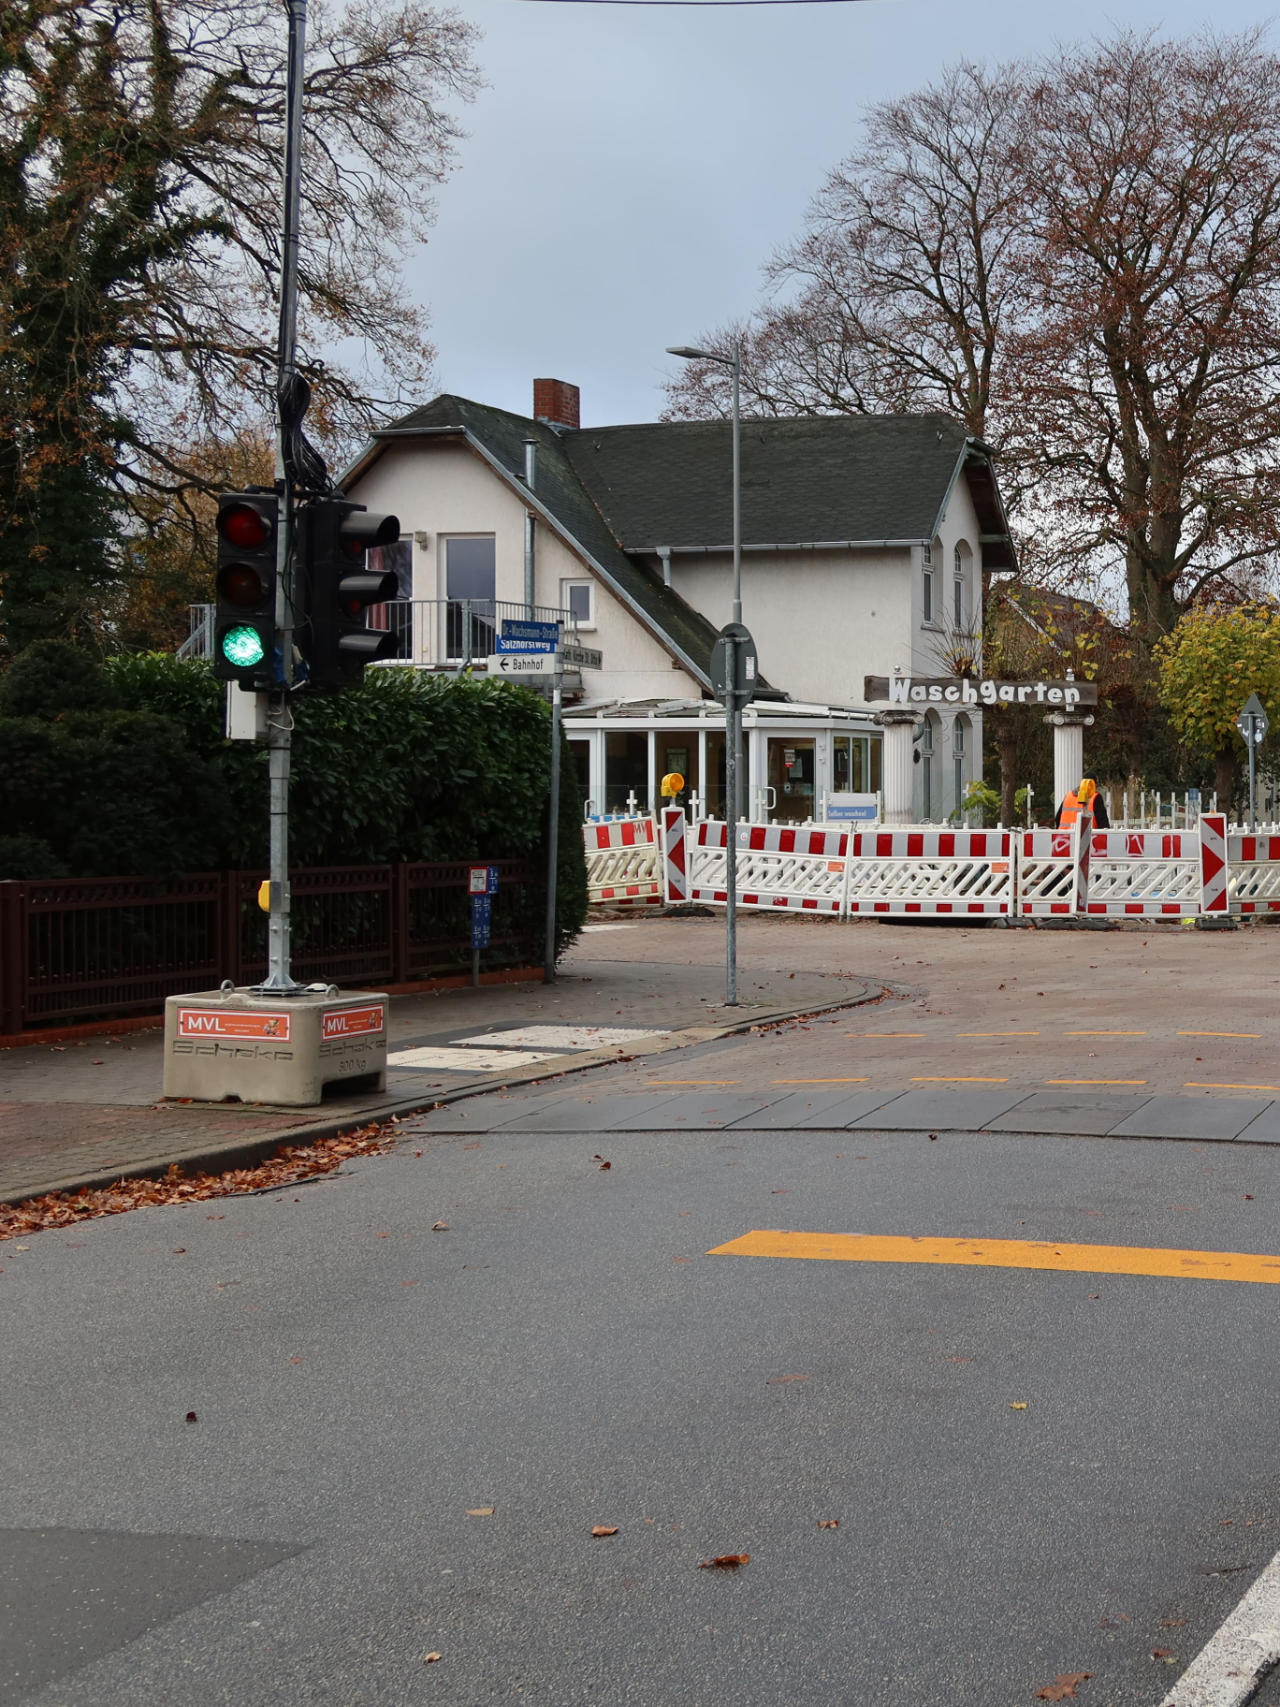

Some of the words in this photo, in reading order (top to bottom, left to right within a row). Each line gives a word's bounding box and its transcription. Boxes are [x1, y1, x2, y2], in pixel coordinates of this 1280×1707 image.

[513, 658, 544, 670] Bahnhof
[888, 676, 1081, 705] Waschgarten
[187, 1016, 227, 1032] MVL
[327, 1016, 349, 1033] MVL
